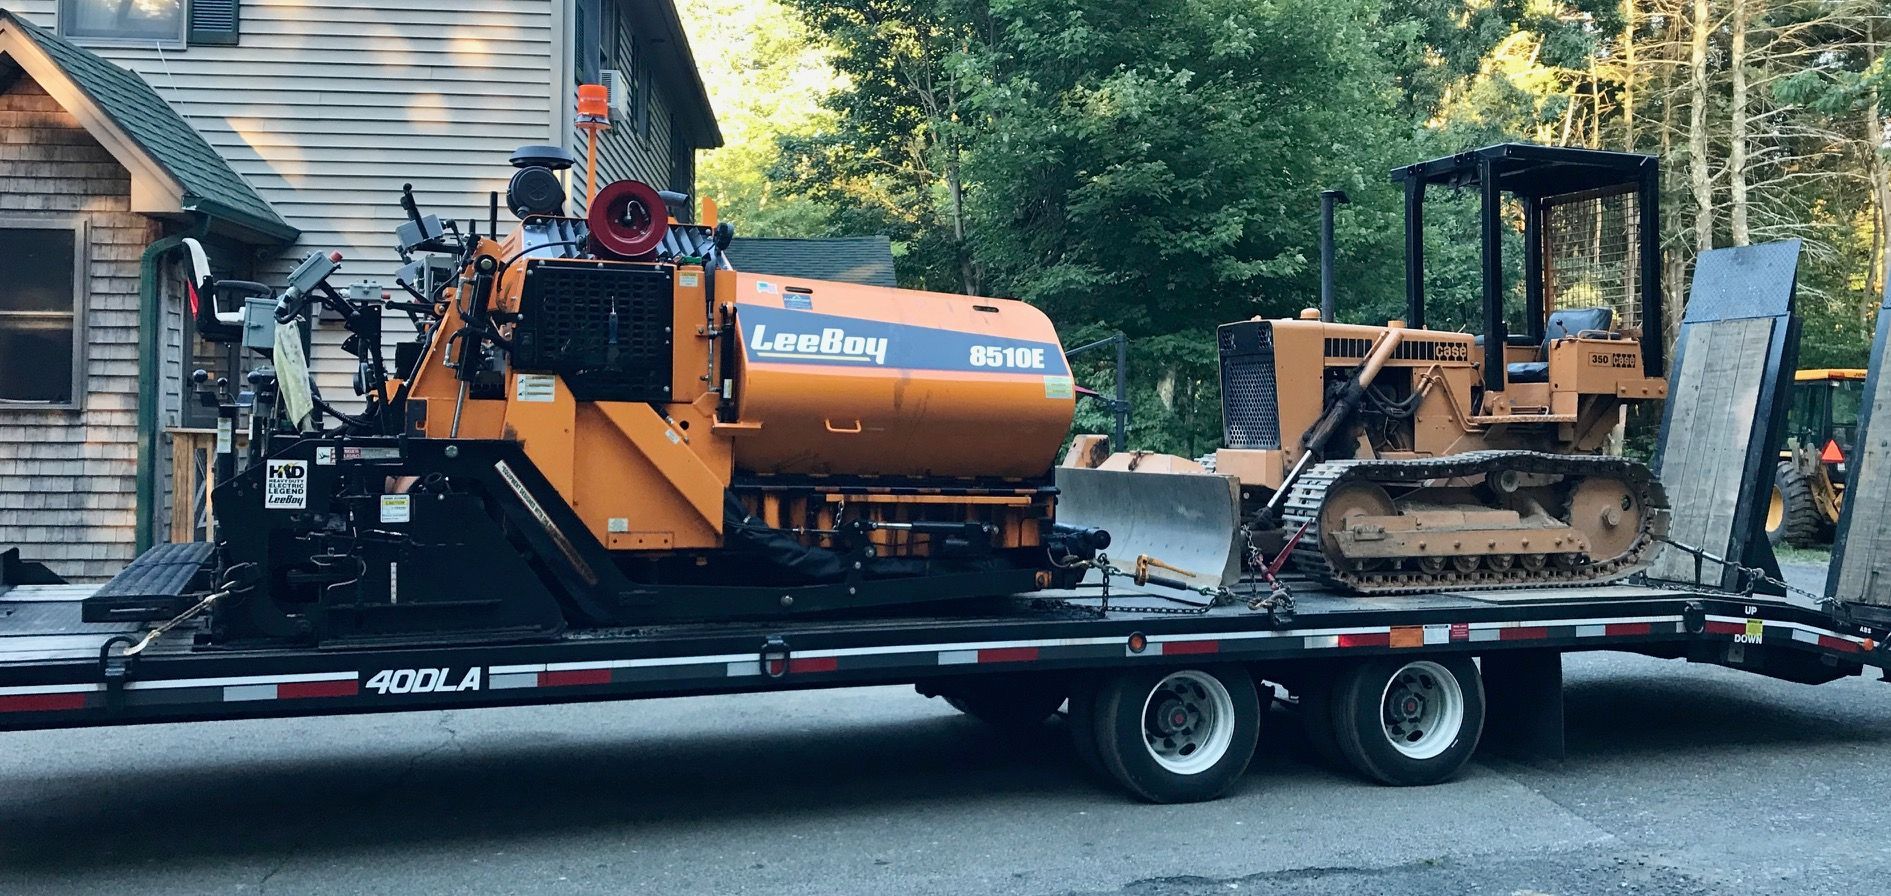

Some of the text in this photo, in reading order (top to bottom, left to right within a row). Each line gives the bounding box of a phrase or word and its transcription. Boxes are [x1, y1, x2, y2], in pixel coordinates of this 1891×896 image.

[751, 324, 888, 365] LeeBoy
[969, 345, 1045, 369] 8510E
[1435, 345, 1467, 358] case
[1592, 354, 1609, 364] 350
[268, 494, 304, 507] LeeBoy
[1744, 605, 1758, 616] UP
[1733, 633, 1763, 645] DOWN
[365, 666, 481, 695] 40DLA
